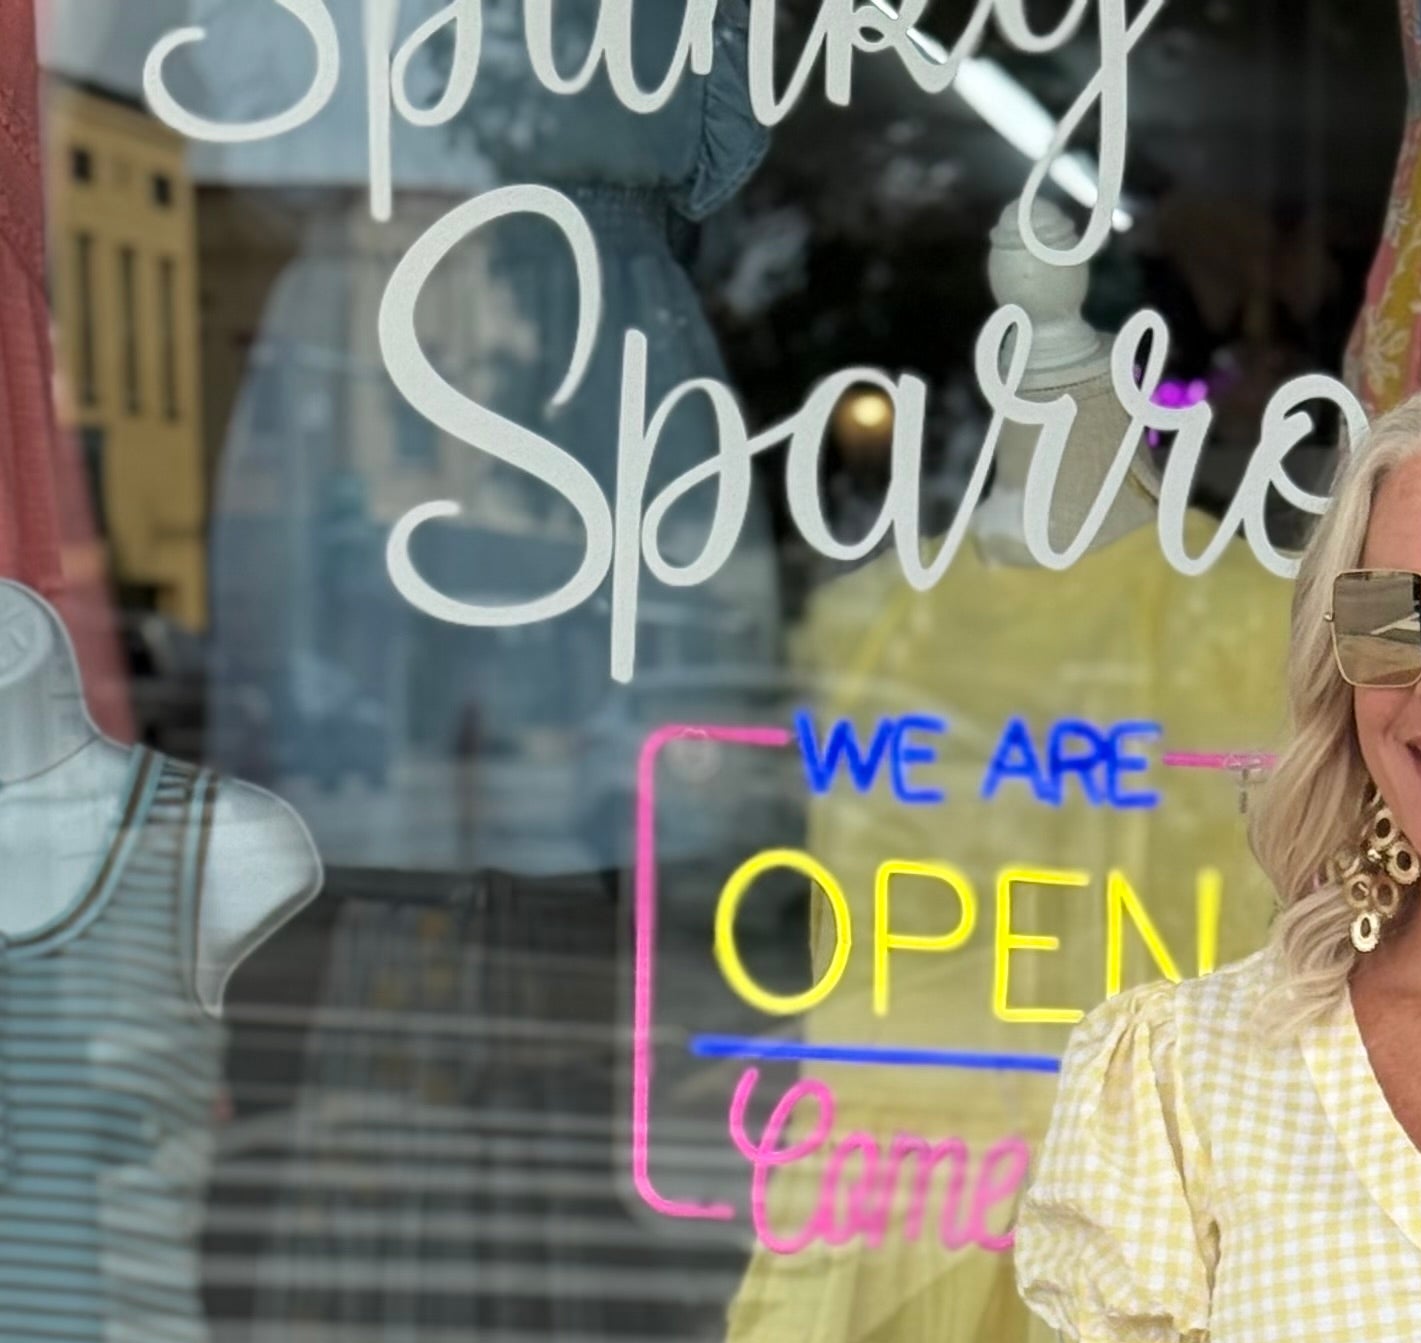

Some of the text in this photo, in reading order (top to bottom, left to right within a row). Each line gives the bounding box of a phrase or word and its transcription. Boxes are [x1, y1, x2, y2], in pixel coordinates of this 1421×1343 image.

[794, 710, 1162, 808] WE ARE
[715, 849, 1222, 1022] OPEN
[729, 1068, 1030, 1254] Come
